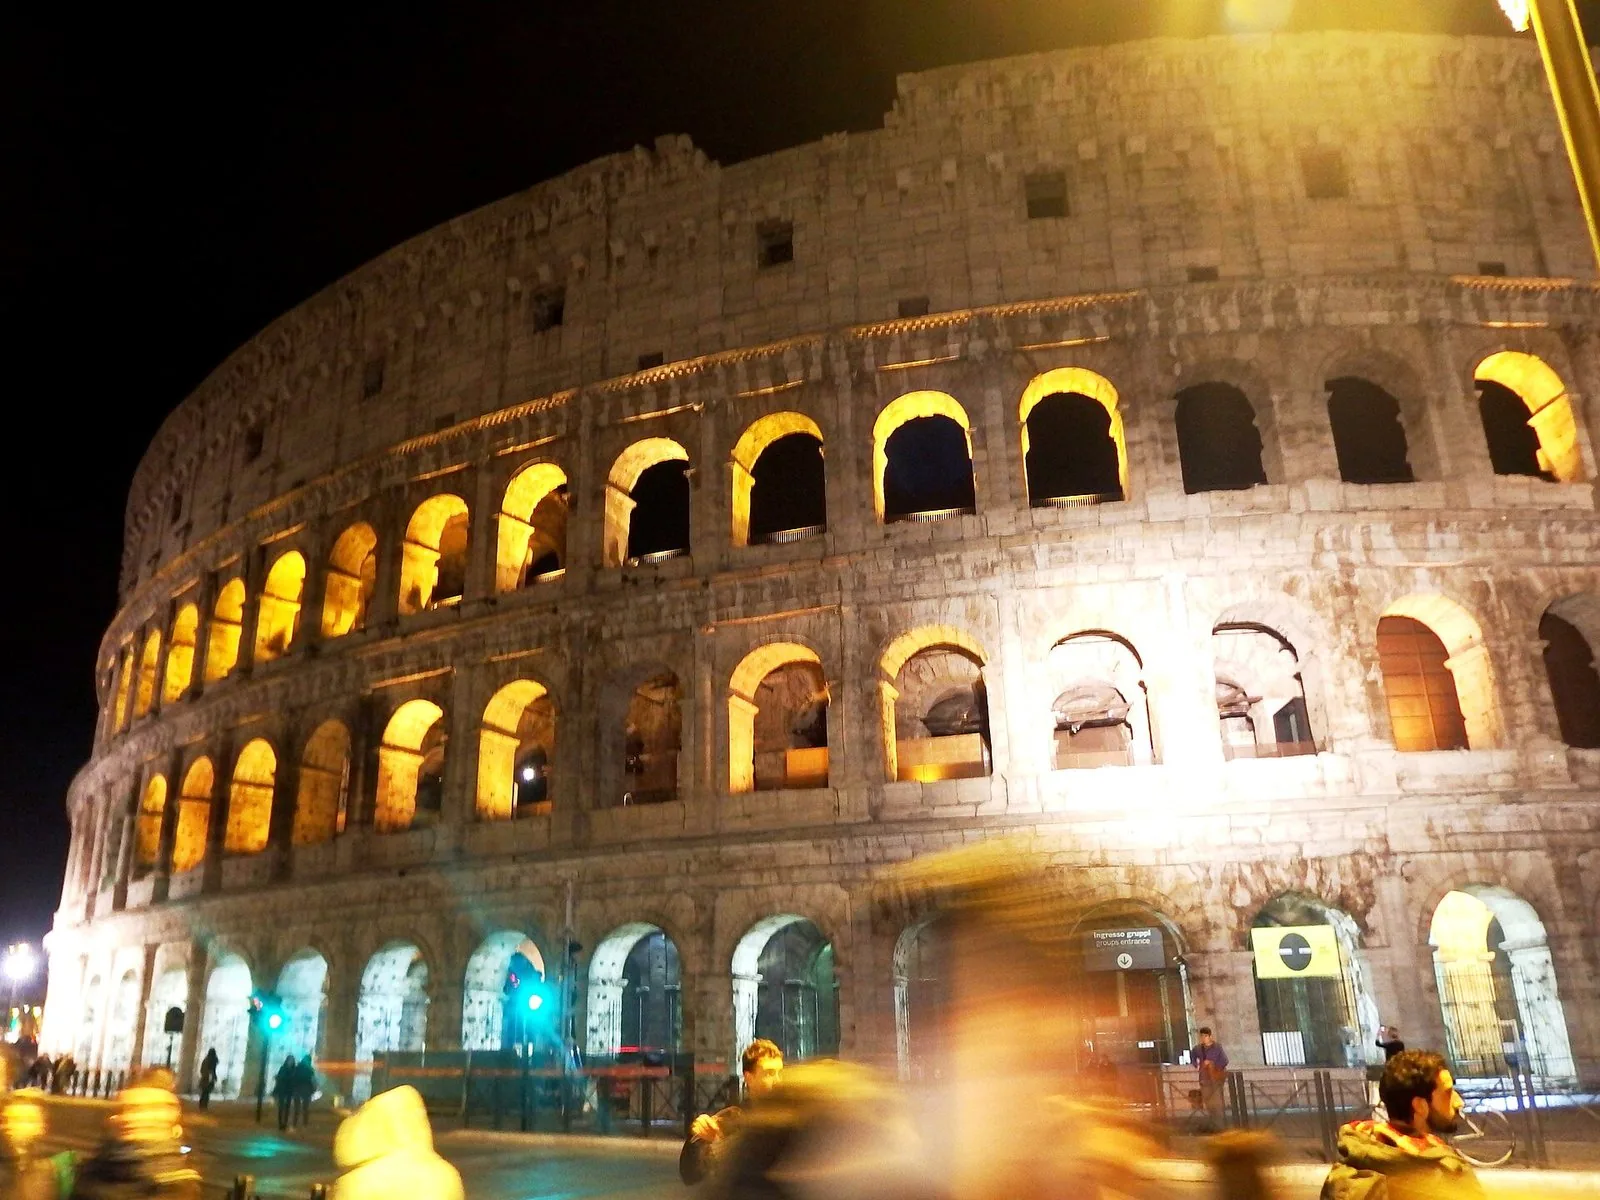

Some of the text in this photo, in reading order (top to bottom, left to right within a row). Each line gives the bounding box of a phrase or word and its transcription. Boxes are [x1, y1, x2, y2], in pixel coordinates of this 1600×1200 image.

[1093, 929, 1152, 939] Ingresso gruppi
[1095, 940, 1119, 948] groups
